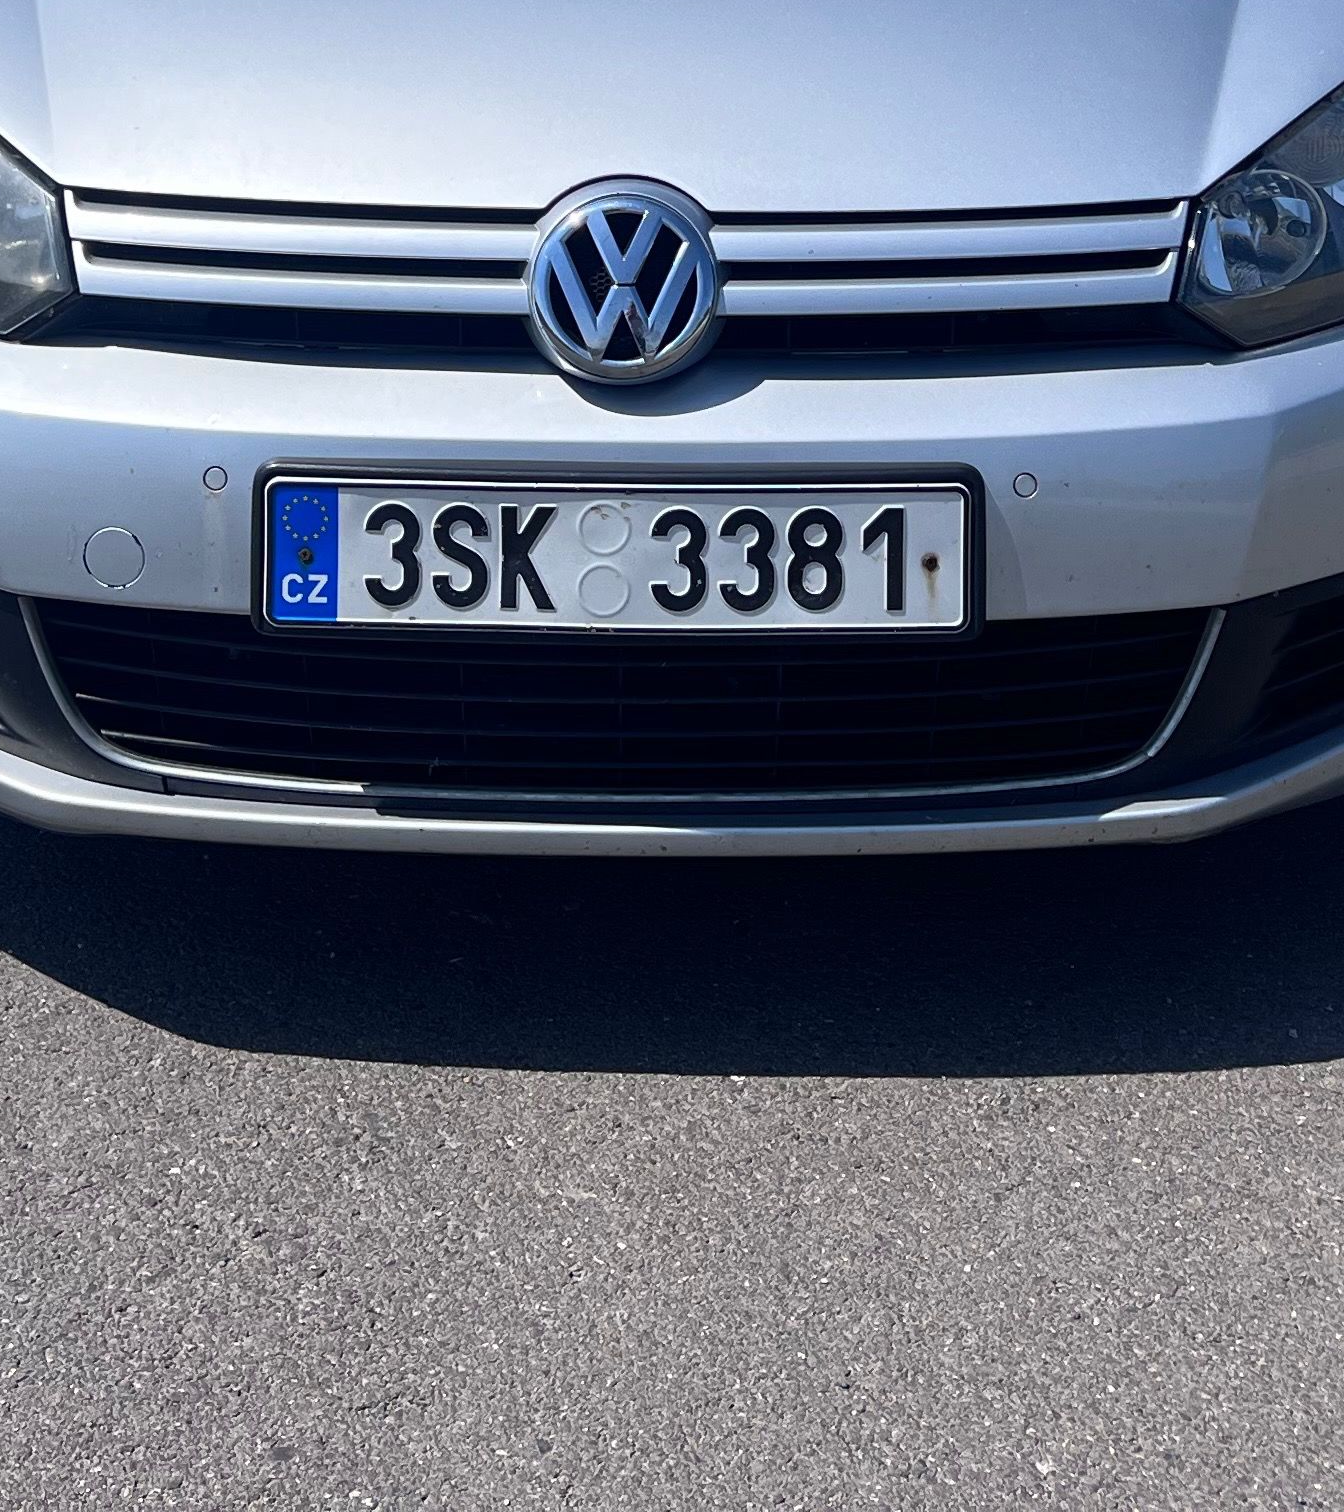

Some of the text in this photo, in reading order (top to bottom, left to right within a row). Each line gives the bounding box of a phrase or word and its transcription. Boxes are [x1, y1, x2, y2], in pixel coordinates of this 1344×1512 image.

[542, 204, 706, 364] VW
[281, 573, 329, 604] CZ
[363, 502, 906, 614] 3SK 3381
